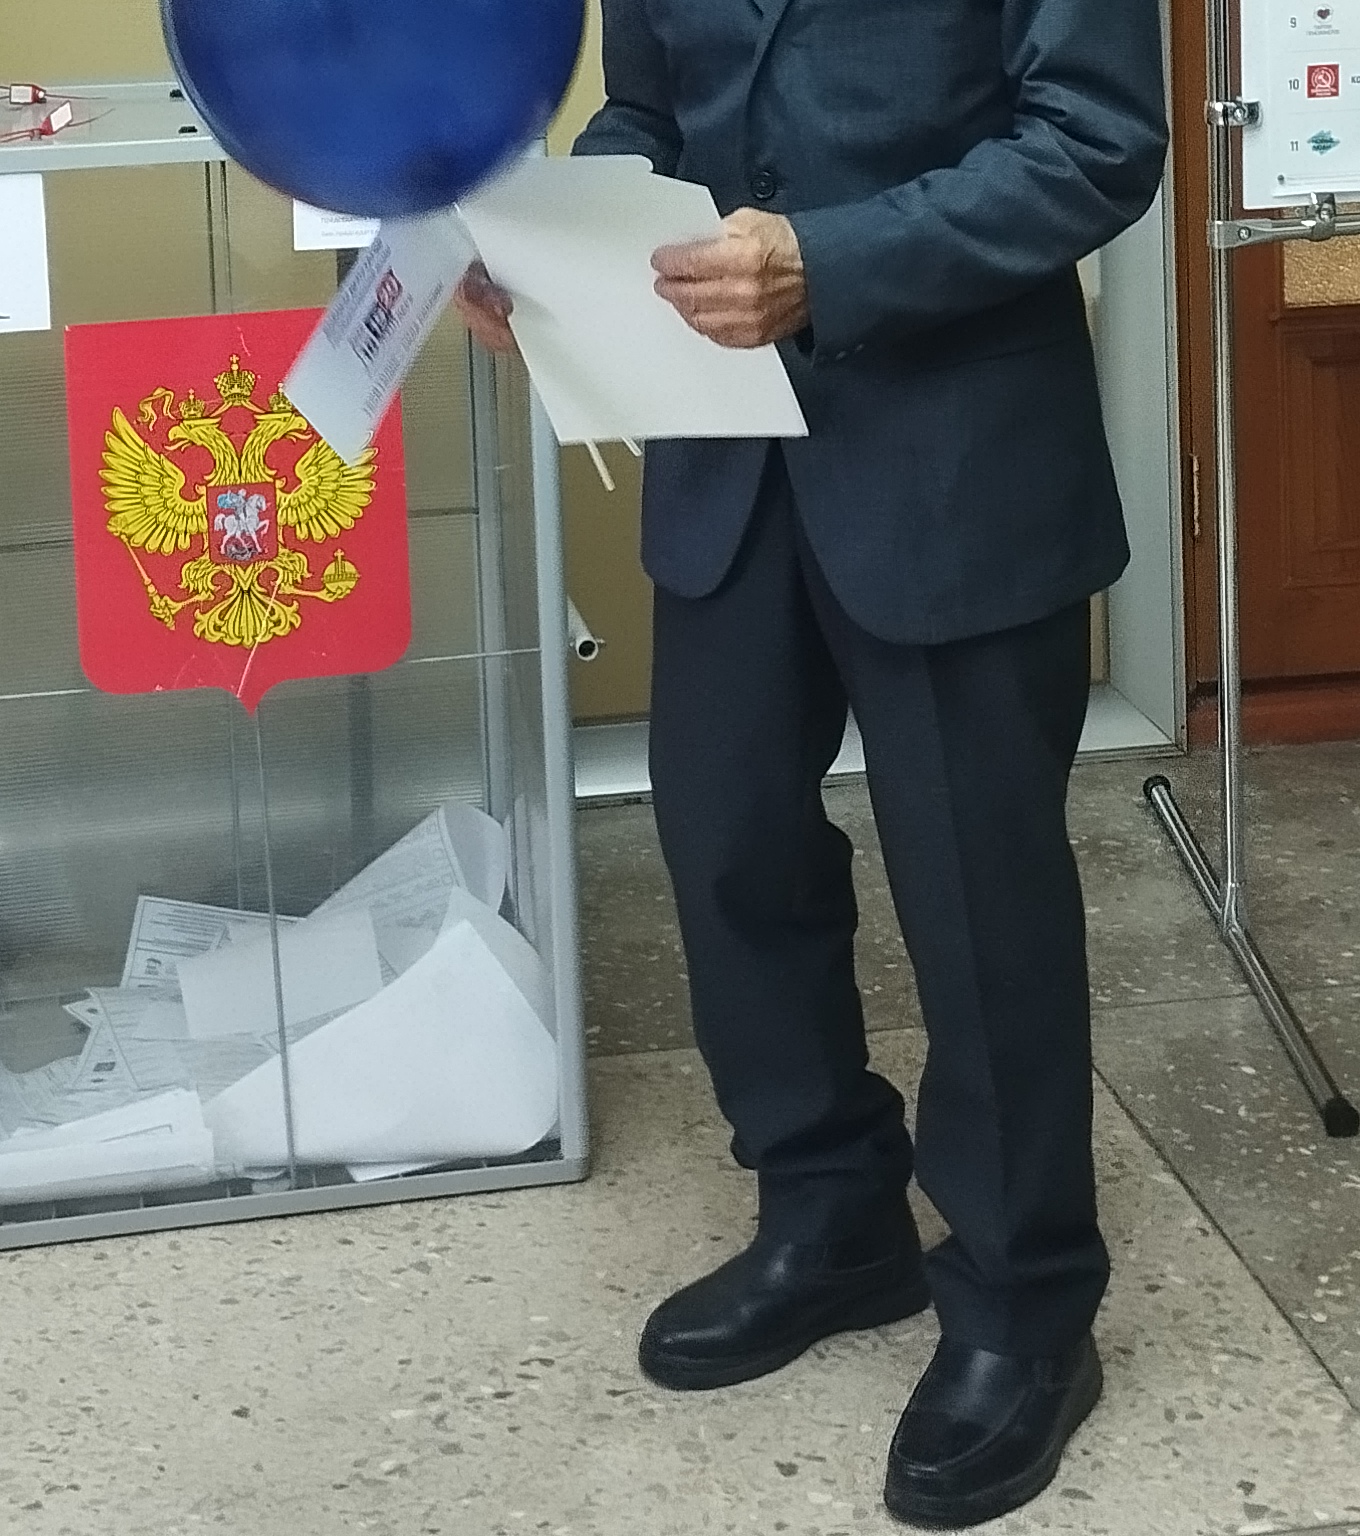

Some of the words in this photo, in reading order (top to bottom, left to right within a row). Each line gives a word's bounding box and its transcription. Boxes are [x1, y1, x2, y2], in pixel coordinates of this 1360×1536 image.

[1290, 17, 1297, 28] 9
[1288, 79, 1300, 90] 10
[1290, 141, 1299, 152] 11
